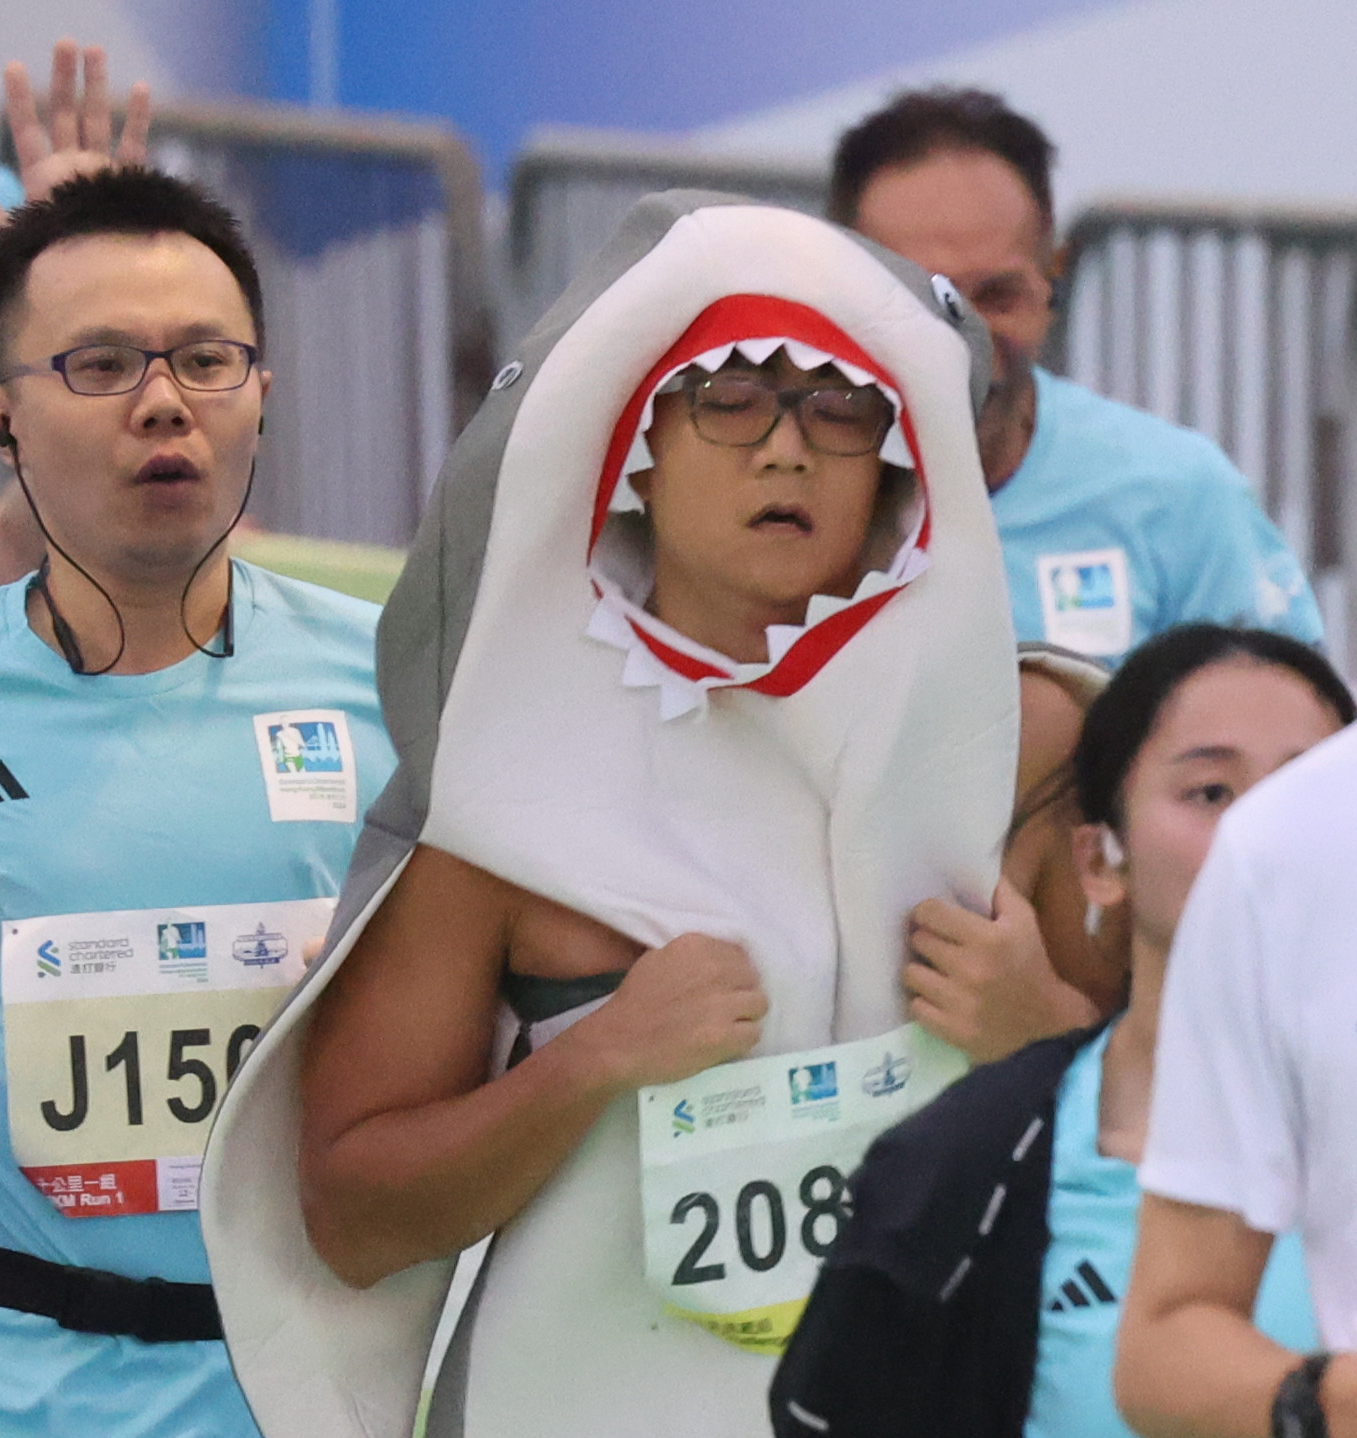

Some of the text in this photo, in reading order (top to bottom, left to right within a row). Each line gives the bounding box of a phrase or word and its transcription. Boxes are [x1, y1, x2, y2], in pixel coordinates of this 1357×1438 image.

[68, 938, 129, 950] standard
[69, 948, 134, 961] chartered
[80, 1193, 111, 1206] Run
[115, 1191, 125, 1205] 1
